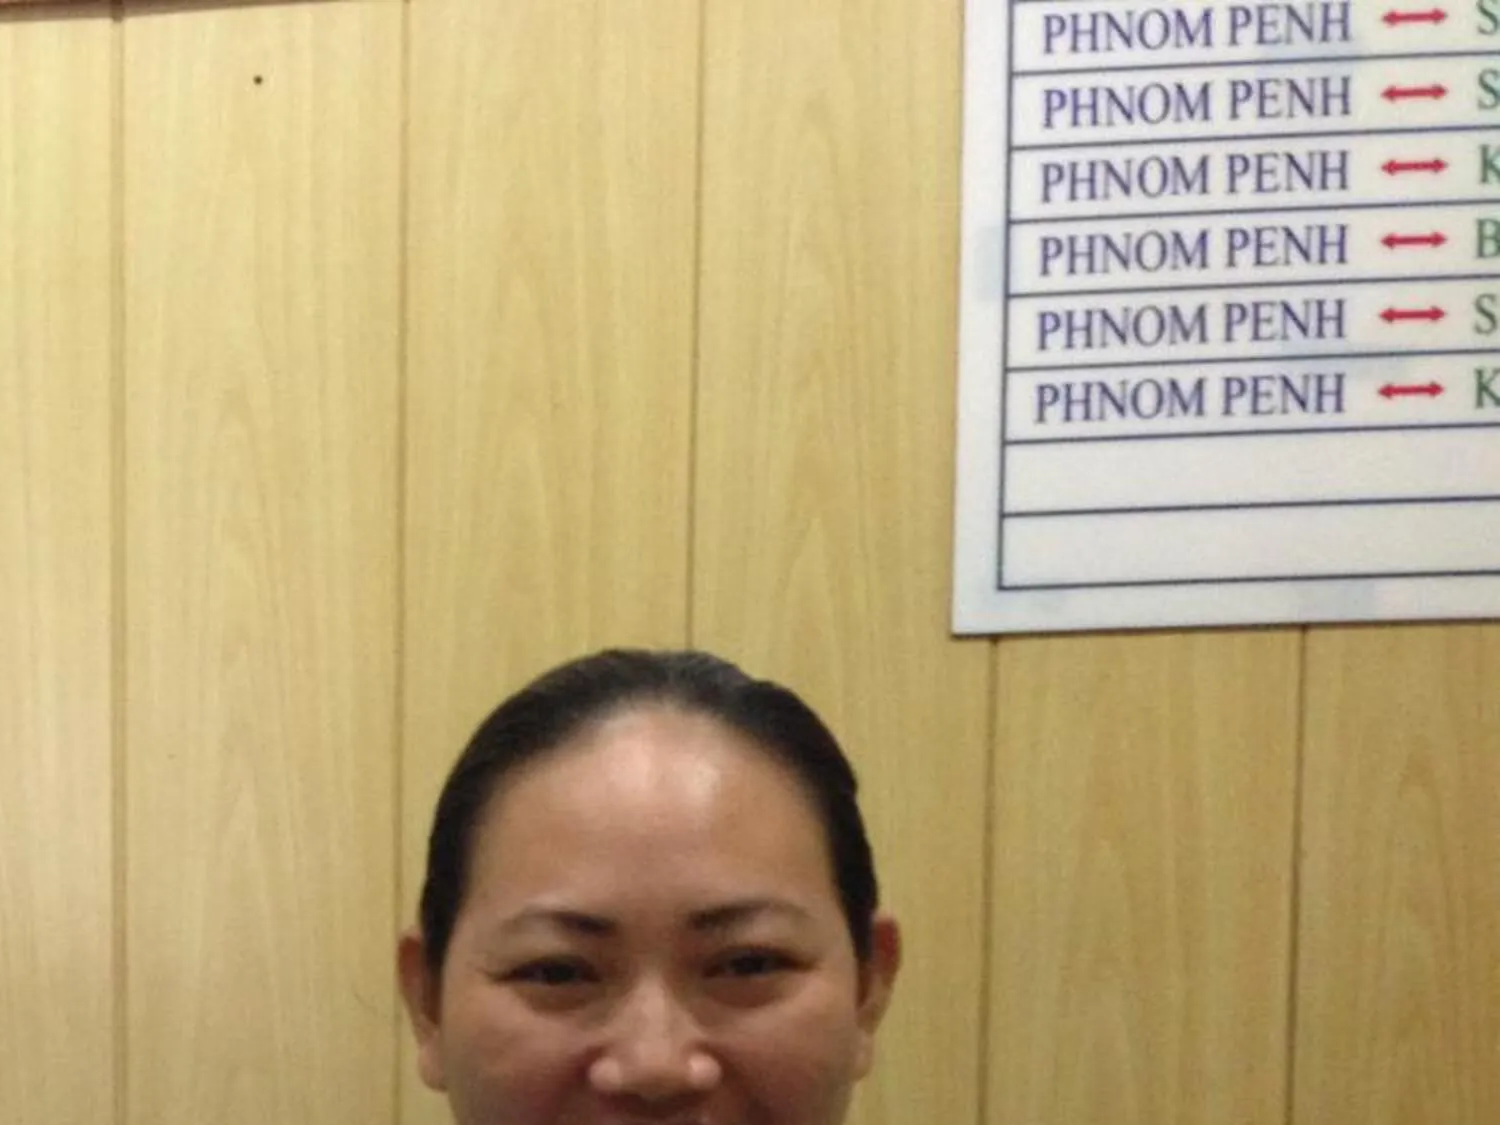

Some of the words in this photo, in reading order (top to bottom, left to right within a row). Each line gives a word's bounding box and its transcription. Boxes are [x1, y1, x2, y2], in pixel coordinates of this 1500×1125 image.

[1042, 8, 1214, 55] PHNOM
[1228, 2, 1352, 46] PENH
[1041, 81, 1213, 130] PHNOM
[1227, 75, 1352, 121] PENH
[1039, 155, 1211, 204] PHNOM
[1224, 149, 1350, 195] PENH
[1038, 228, 1210, 277] PHNOM
[1224, 223, 1349, 269] PENH
[1036, 303, 1209, 351] PHNOM
[1223, 298, 1348, 342] PENH
[1033, 376, 1208, 425] PHNOM
[1220, 372, 1346, 416] PENH
